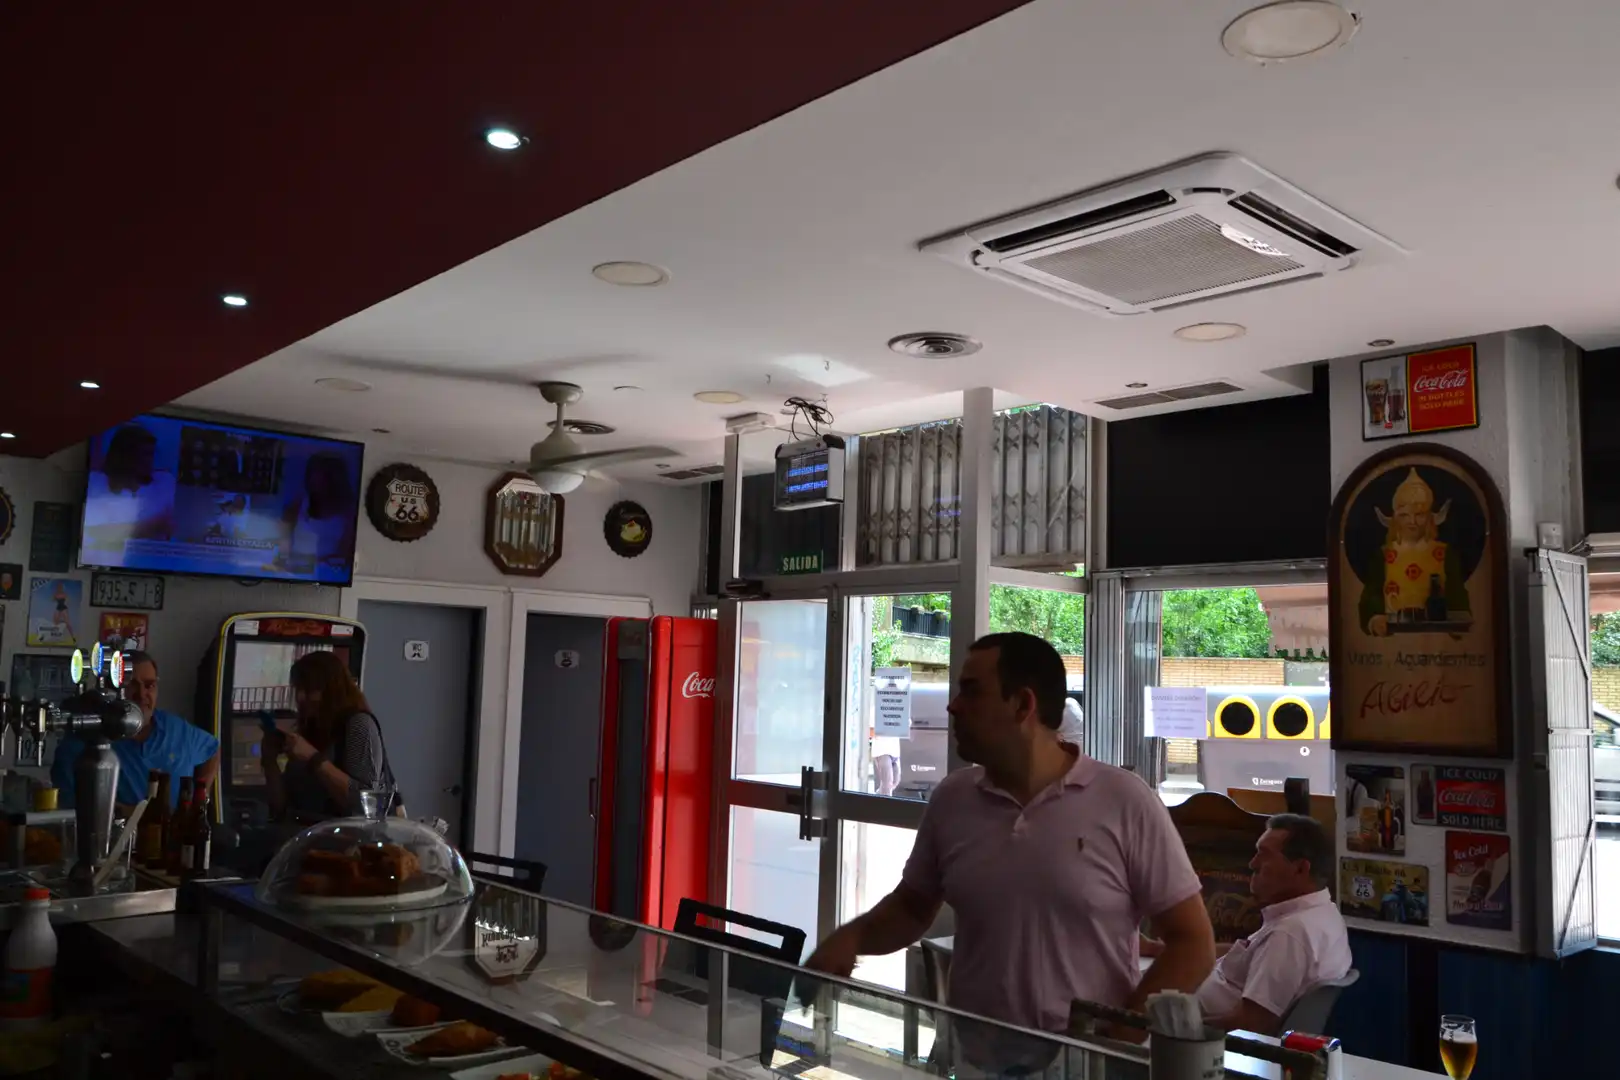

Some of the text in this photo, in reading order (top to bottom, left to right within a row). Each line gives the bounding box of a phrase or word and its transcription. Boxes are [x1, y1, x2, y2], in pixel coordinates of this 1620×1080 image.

[395, 483, 424, 495] ROUTE
[396, 502, 420, 521] 66
[782, 555, 819, 571] SALIDA
[1348, 650, 1384, 666] Vinos
[1442, 767, 1461, 779] ICE
[1442, 814, 1503, 830] SOLD HERE
[1356, 887, 1371, 898] 66
